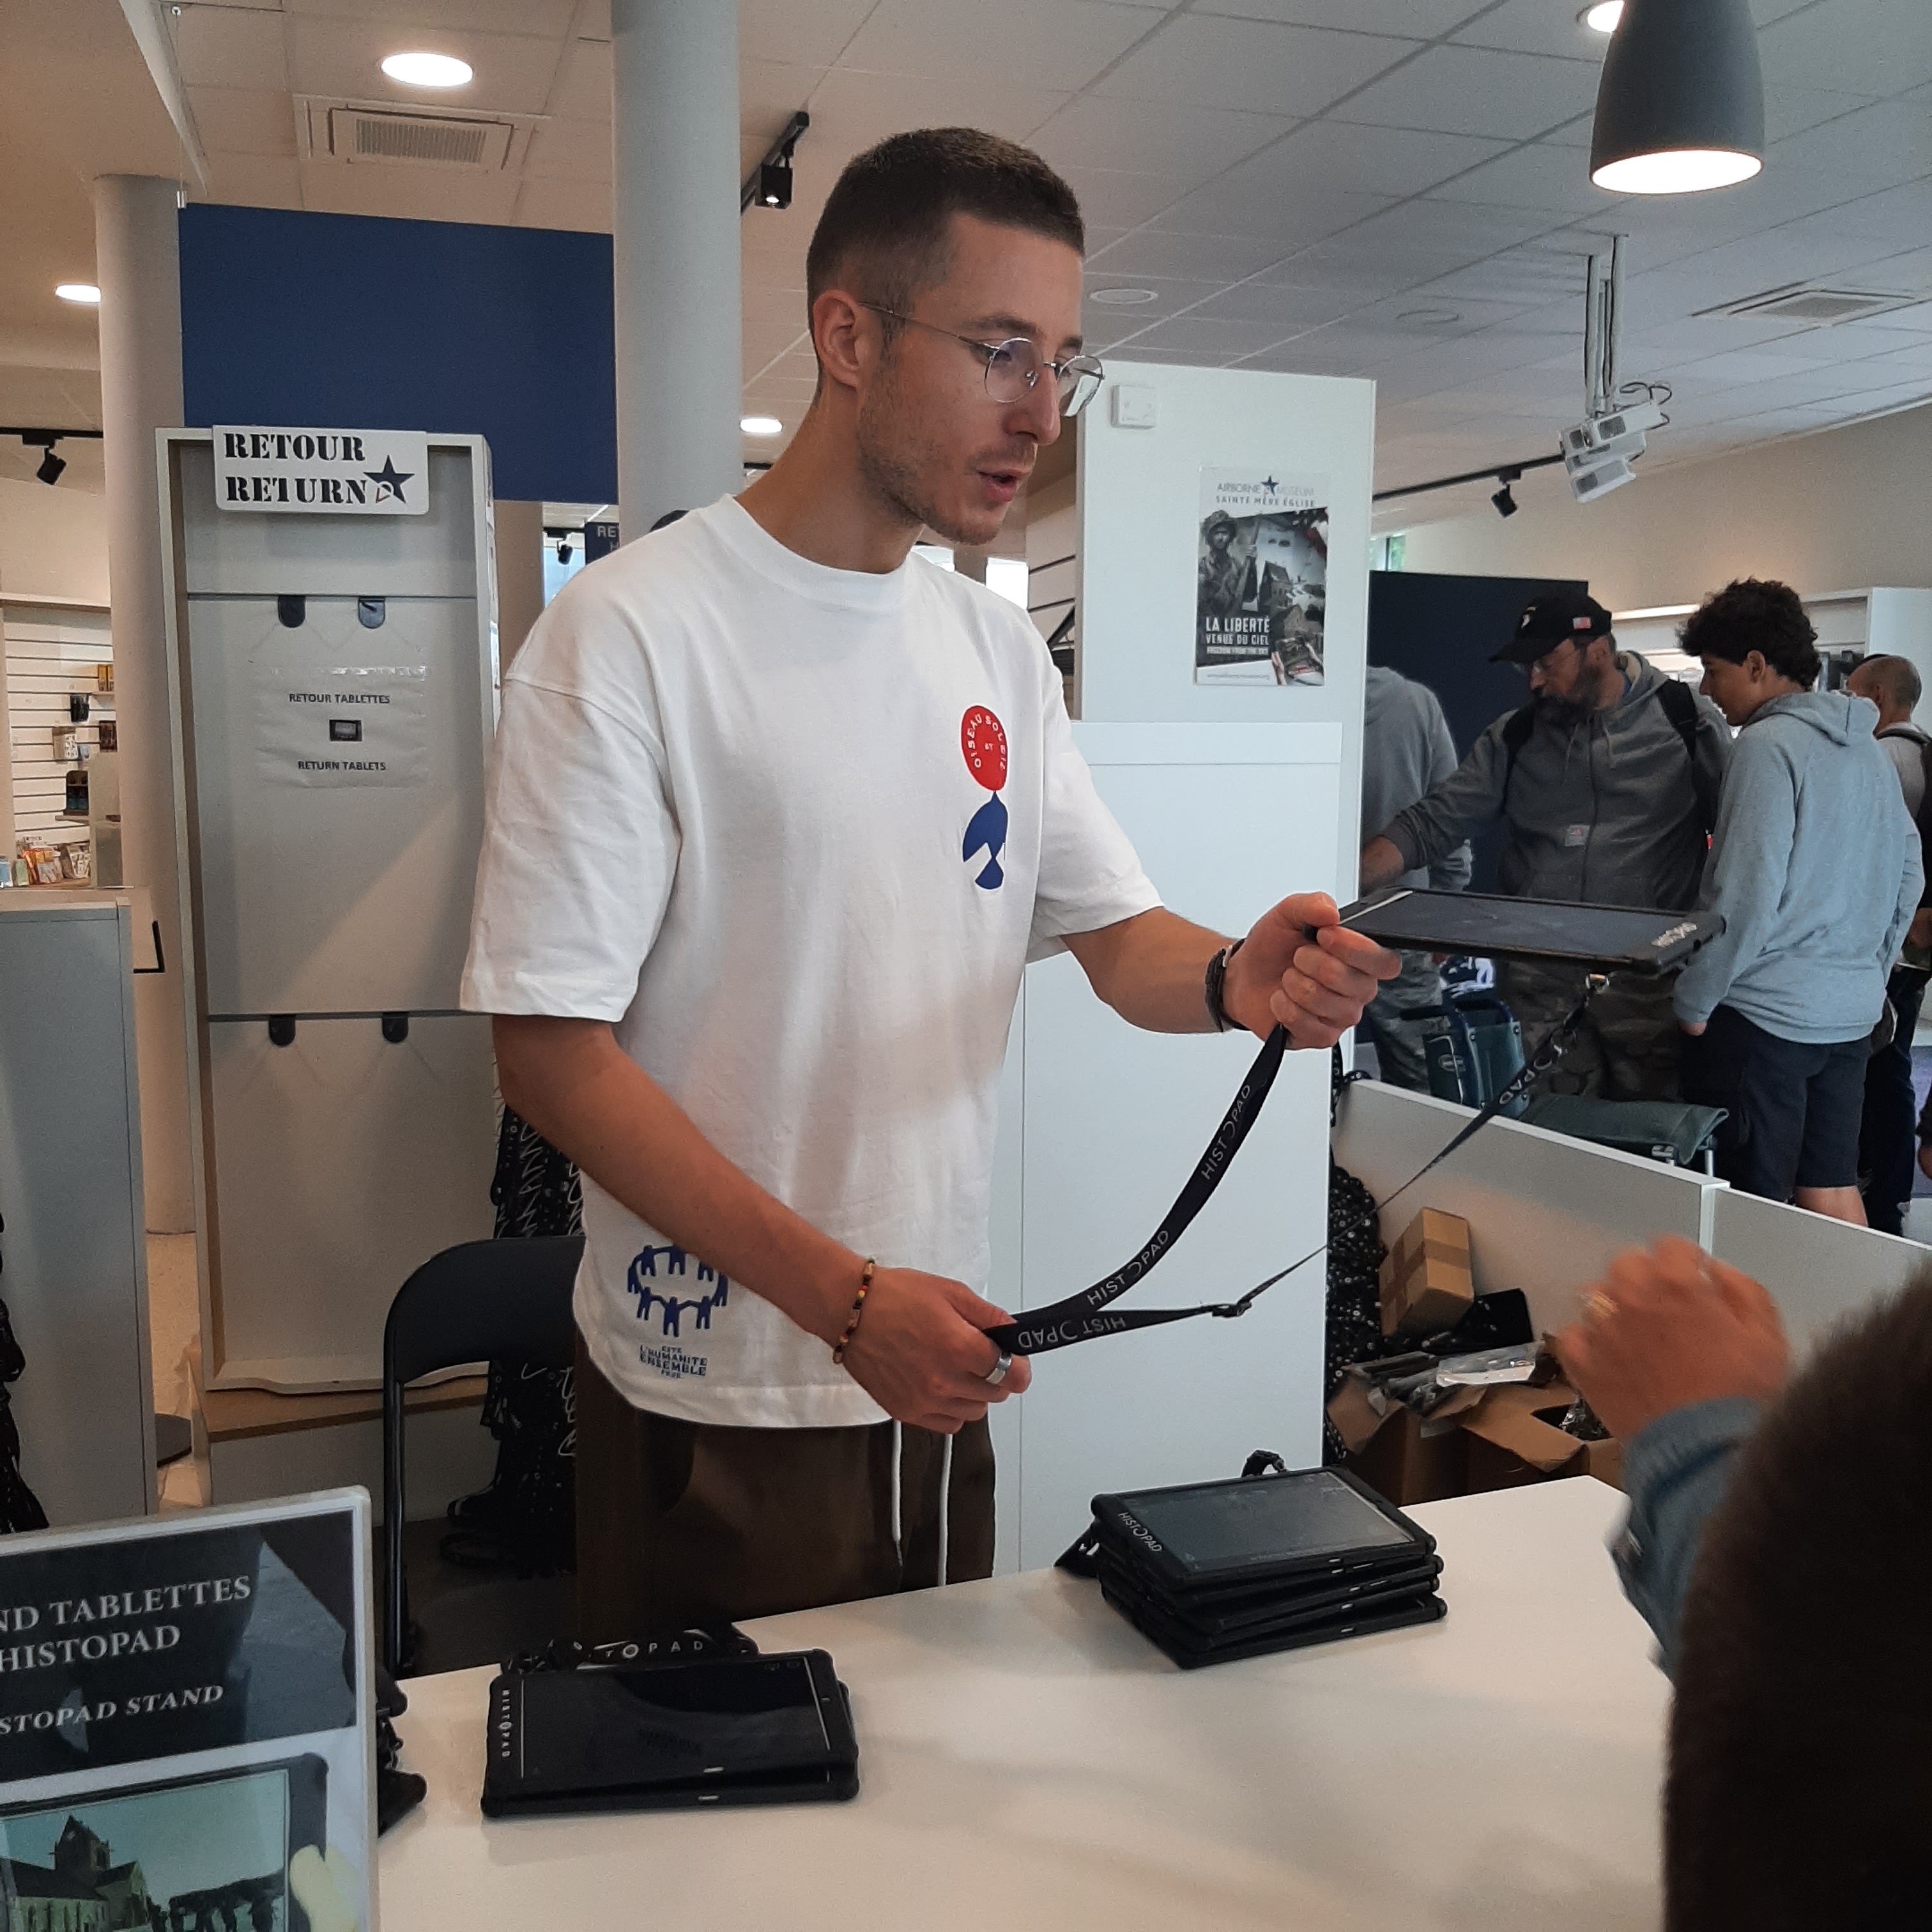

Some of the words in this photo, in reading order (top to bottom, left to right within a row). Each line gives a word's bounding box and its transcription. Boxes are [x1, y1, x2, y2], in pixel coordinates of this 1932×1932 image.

[224, 433, 365, 461] RETOUR
[226, 476, 367, 503] RETURN
[1216, 495, 1250, 505] SAINTE
[1206, 617, 1220, 632] LA
[1224, 615, 1270, 633] LIBERTÉ
[1206, 634, 1233, 645] VENUE
[1237, 634, 1248, 645] DU
[289, 693, 331, 703] RETOUR
[335, 694, 390, 704] TABLETTES
[298, 761, 339, 770] RETURN
[342, 762, 387, 770] TABLETS
[49, 1575, 251, 1625] TABLETTES
[0, 1625, 181, 1673] HISTOPAD
[126, 1685, 224, 1715] STAND
